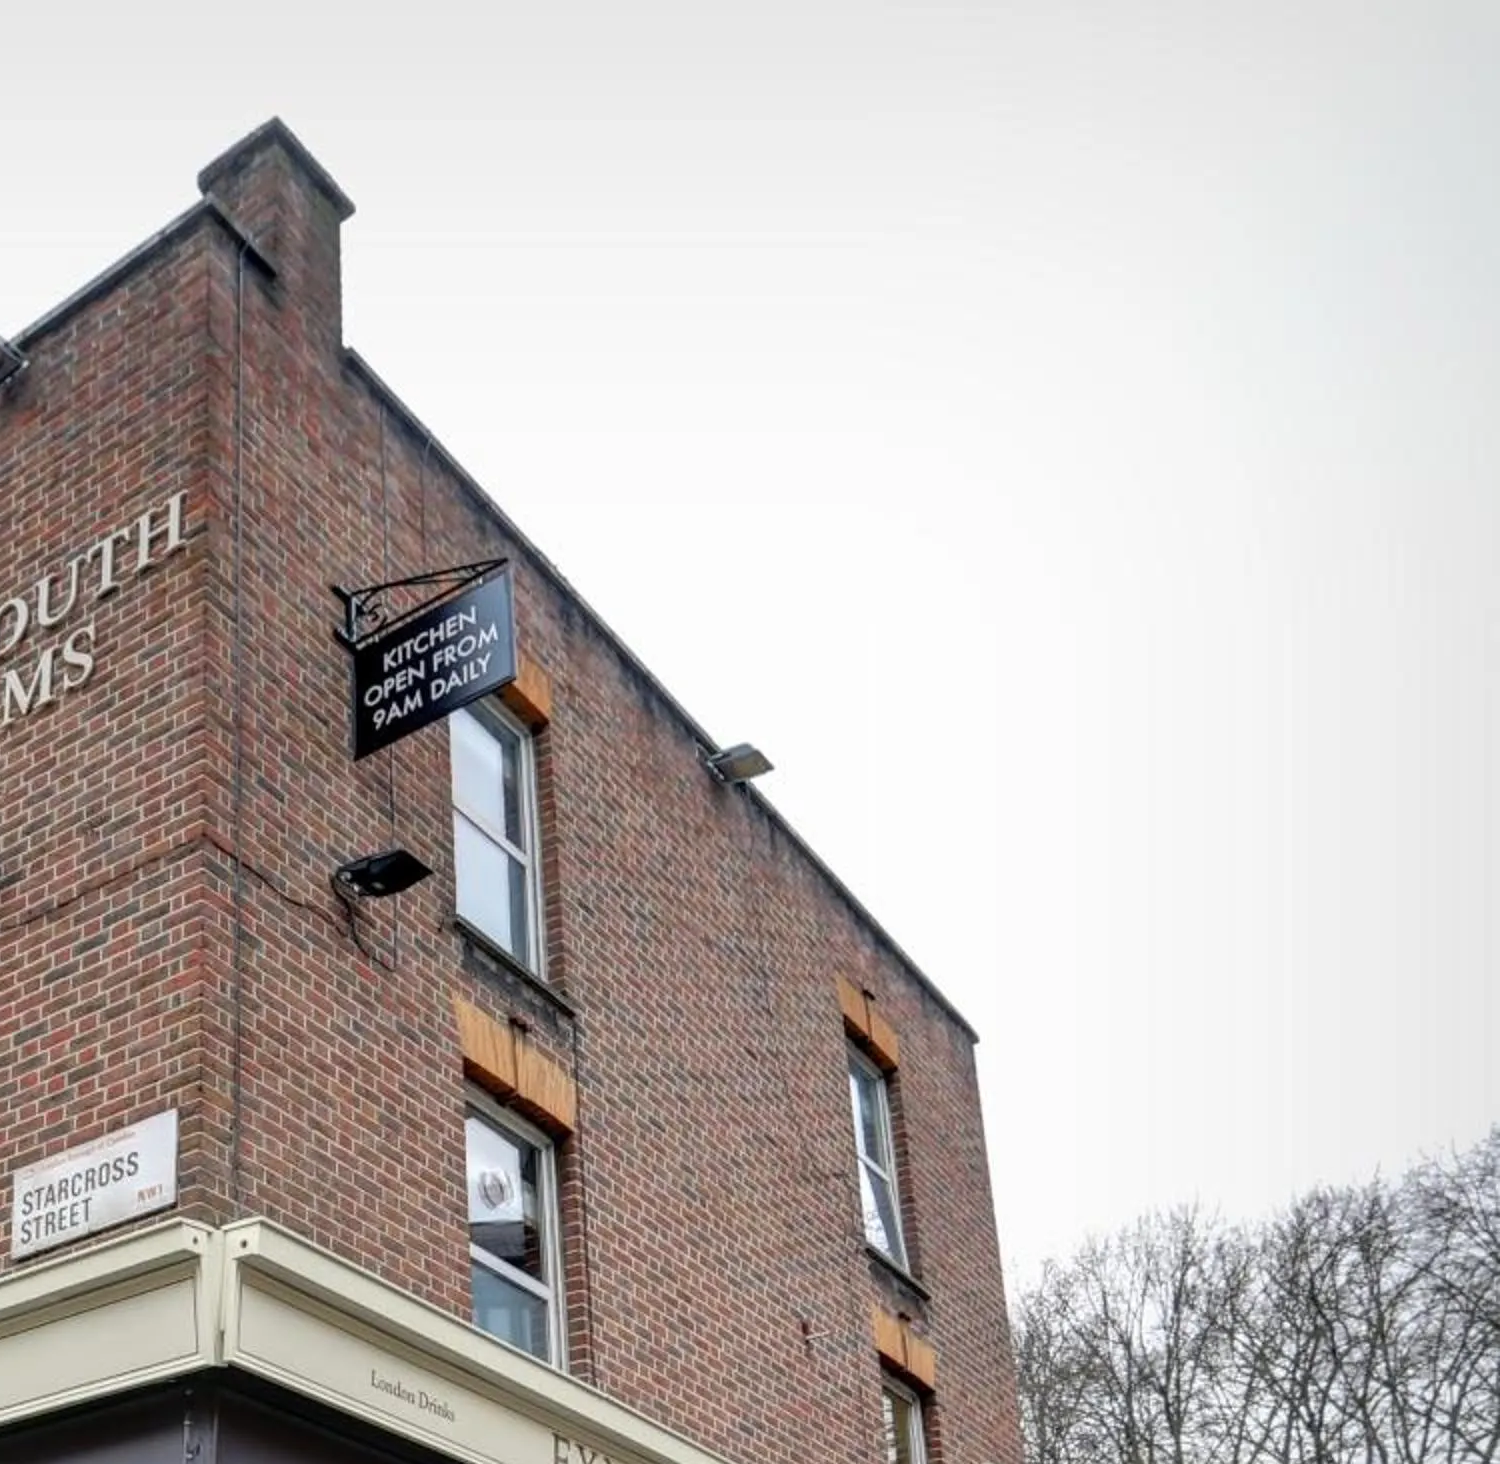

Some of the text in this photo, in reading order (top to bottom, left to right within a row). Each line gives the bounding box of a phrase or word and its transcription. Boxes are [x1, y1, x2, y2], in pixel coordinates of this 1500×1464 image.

[364, 623, 498, 707] OPEN FROM
[383, 605, 476, 672] KITCHEN
[372, 653, 492, 730] 9AM DAILY
[21, 1184, 163, 1244] STREET NW1
[22, 1152, 139, 1215] STARCROSS
[371, 1368, 415, 1405] London
